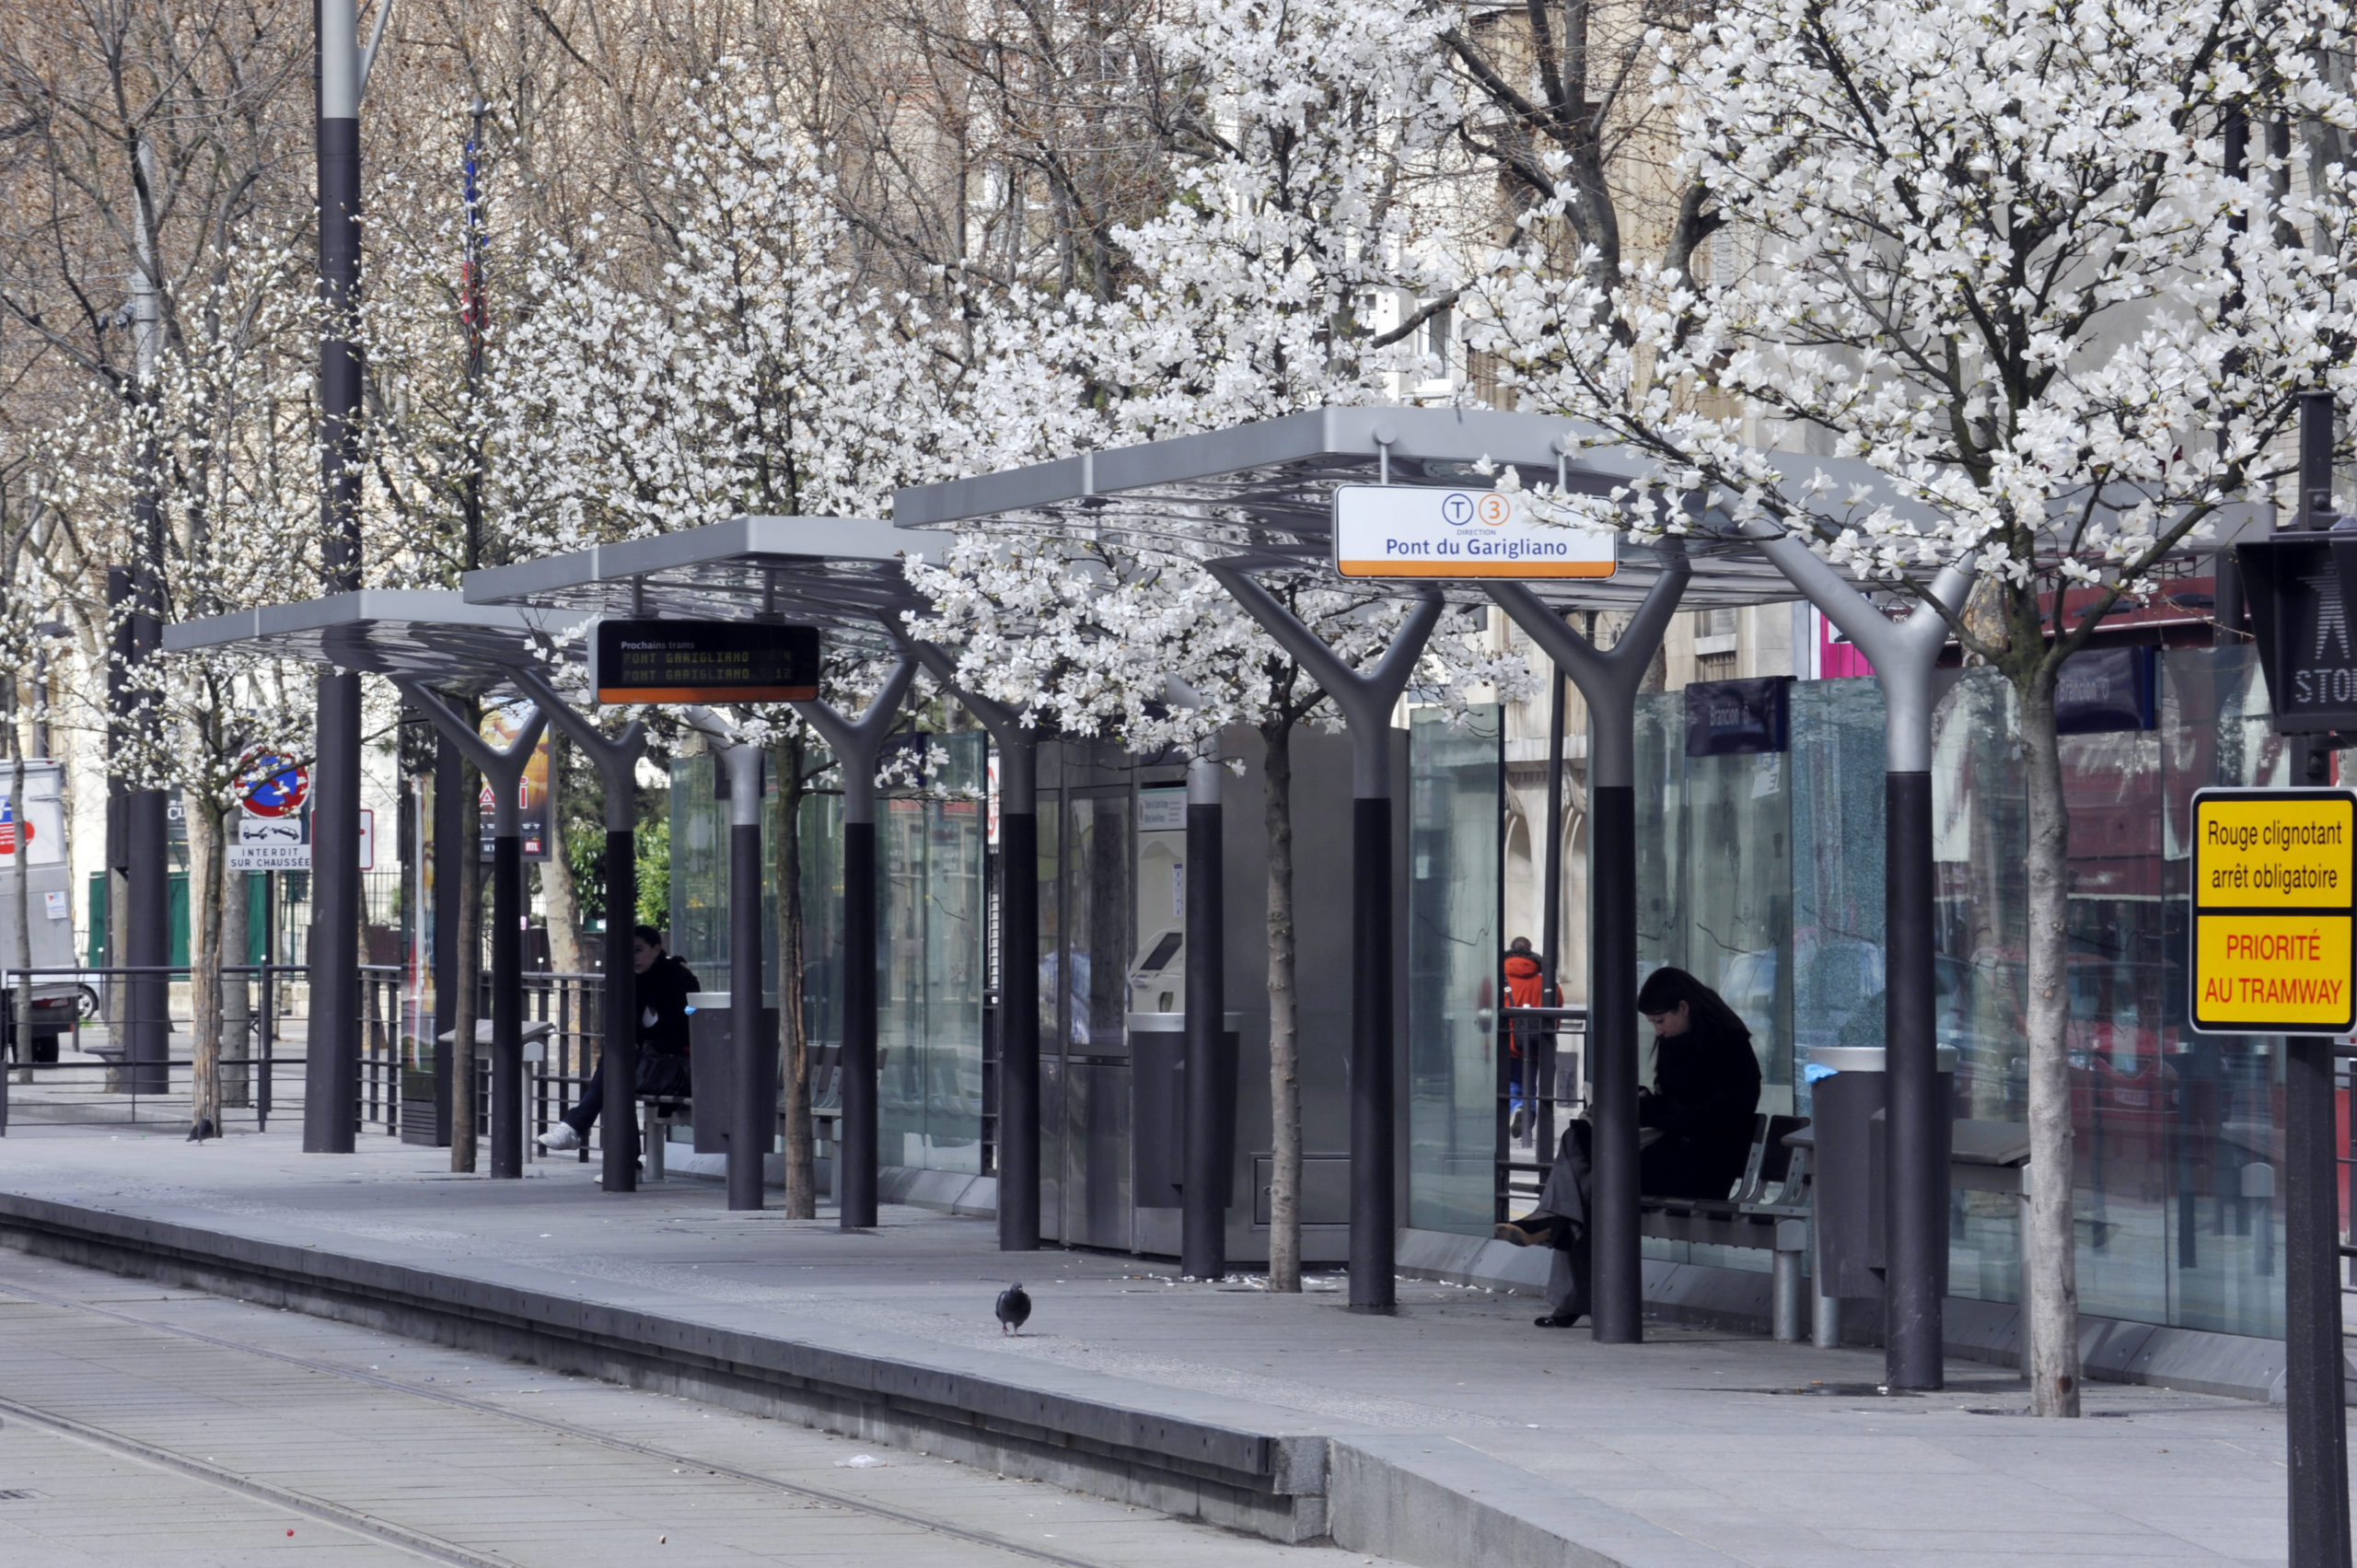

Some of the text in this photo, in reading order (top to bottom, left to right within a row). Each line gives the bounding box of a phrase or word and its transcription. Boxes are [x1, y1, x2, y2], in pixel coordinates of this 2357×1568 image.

[1387, 539, 1567, 559] Pont du Garigliano
[621, 641, 695, 650] Prochains trams
[623, 653, 656, 664] PONT
[666, 652, 749, 664] GARIGLIANO
[623, 671, 656, 681] PONT
[2295, 668, 2357, 703] STO
[2208, 819, 2342, 852] Rouge clignotant
[230, 857, 310, 867] SUR CHAUSSÉE
[242, 848, 298, 856] INTERDIT
[2212, 863, 2339, 895] arrêt obligatoire
[2226, 928, 2321, 961] PRIORITÉ
[2204, 978, 2343, 1005] AU TRAMWAY
